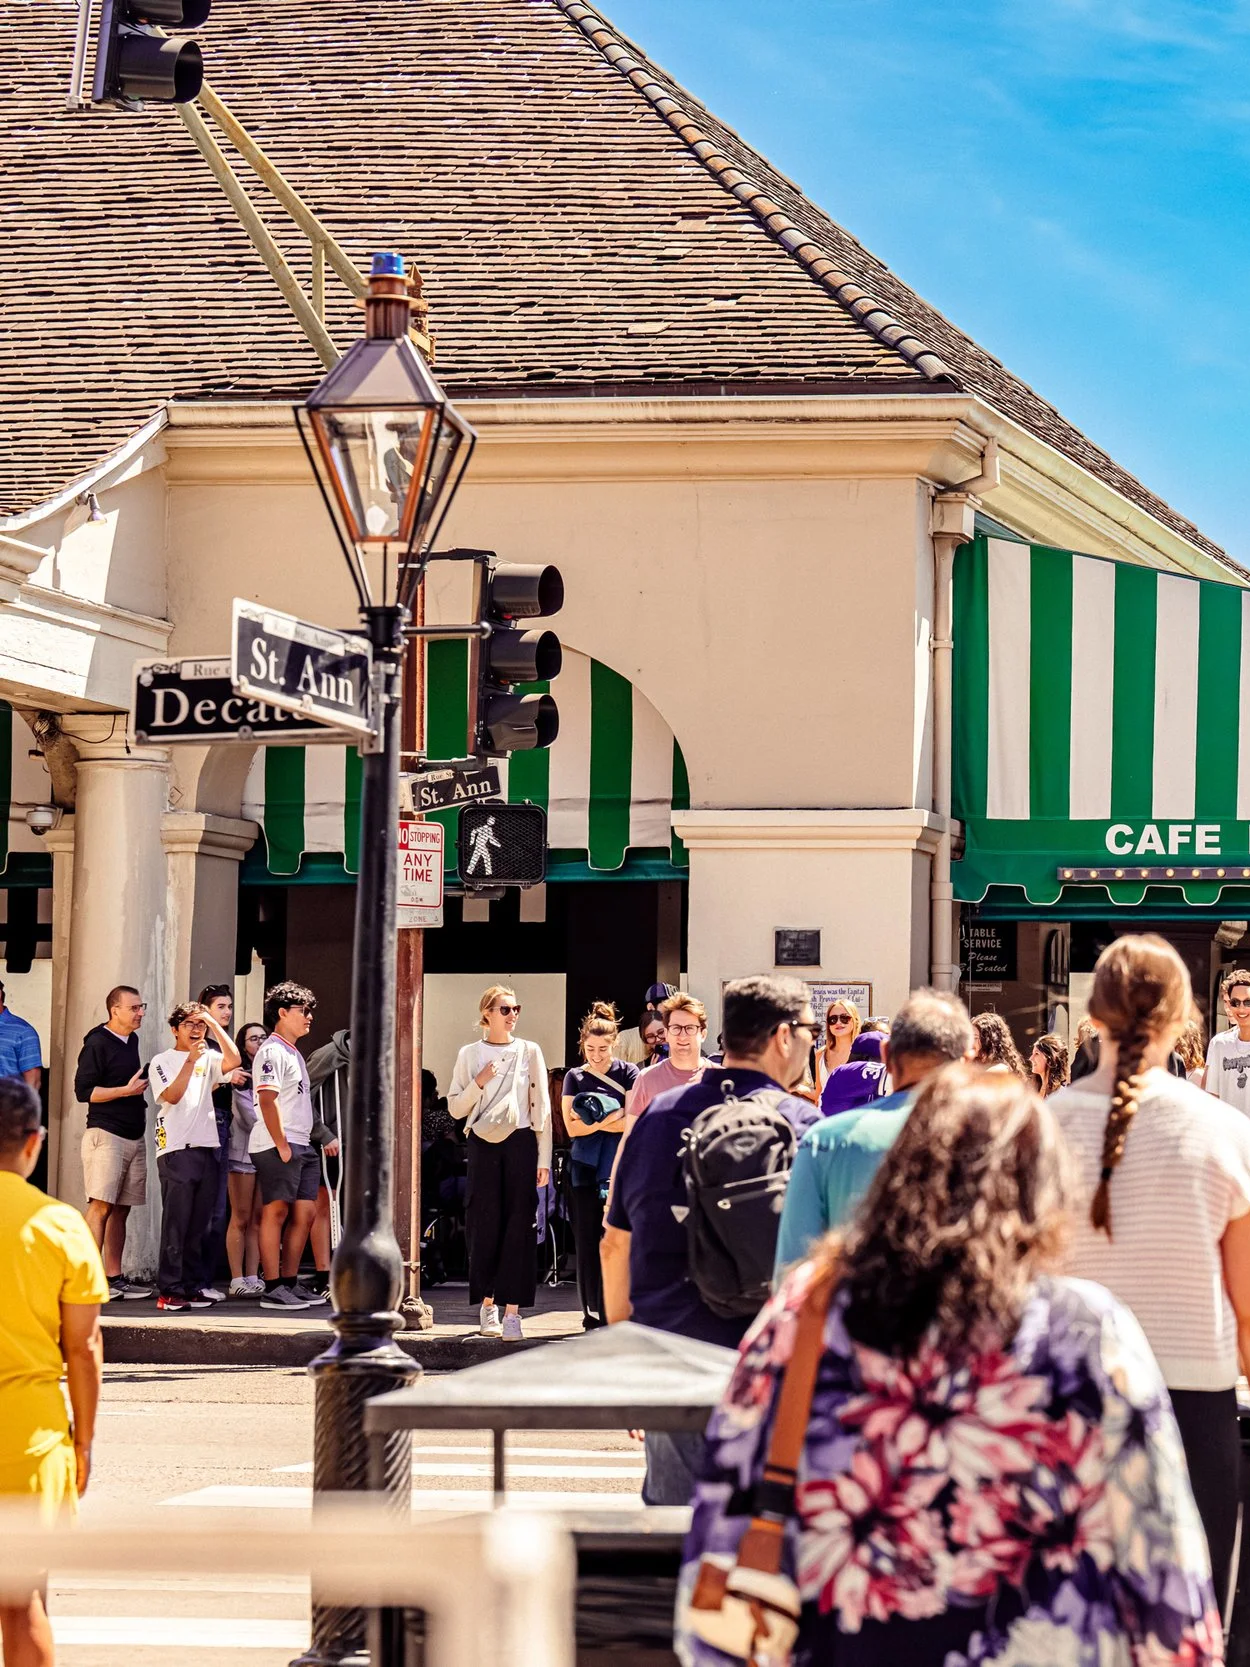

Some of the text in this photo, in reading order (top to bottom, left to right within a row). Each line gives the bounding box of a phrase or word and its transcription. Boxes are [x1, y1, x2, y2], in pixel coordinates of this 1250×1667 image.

[193, 663, 220, 677] Rue
[251, 637, 355, 707] St. Ann
[420, 779, 494, 807] St. Ann
[410, 831, 440, 844] STOPPING
[1105, 823, 1221, 855] CAFE
[403, 853, 432, 867] ANY
[403, 868, 433, 883] TIME
[969, 928, 996, 938] TABLE
[963, 939, 1002, 948] SERVICE
[968, 952, 998, 961] Please
[976, 963, 1008, 972] Seated
